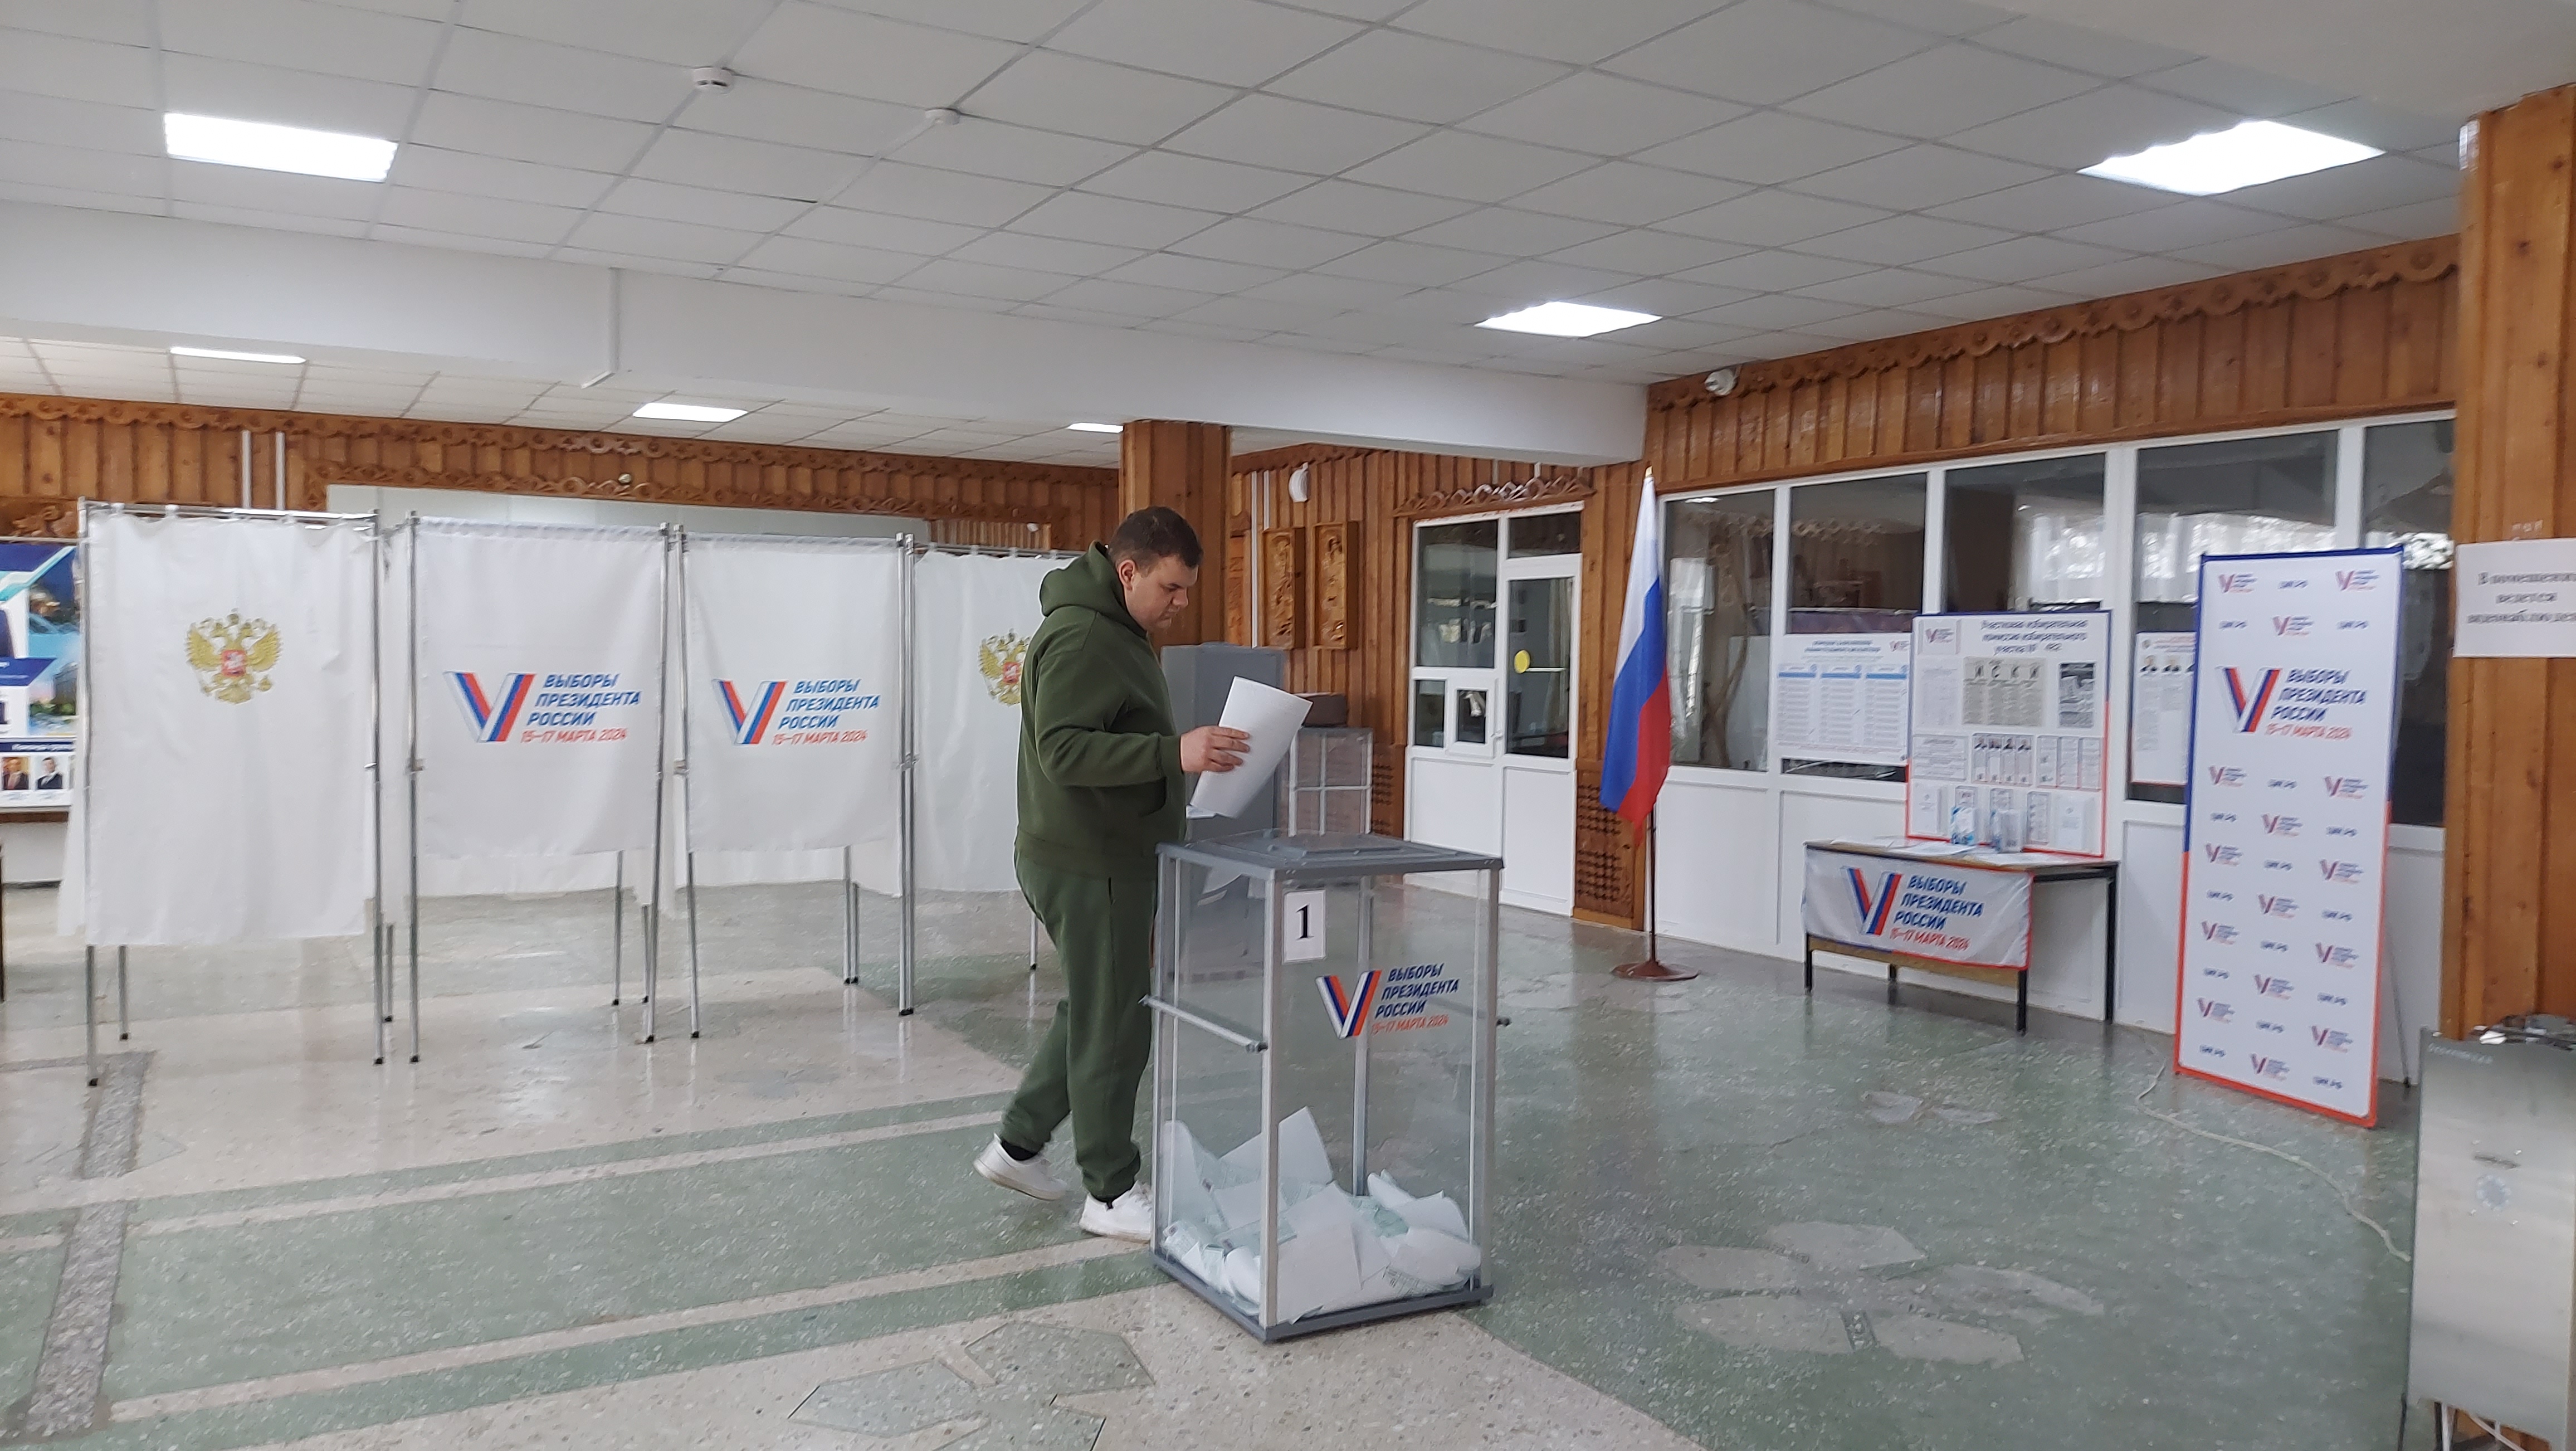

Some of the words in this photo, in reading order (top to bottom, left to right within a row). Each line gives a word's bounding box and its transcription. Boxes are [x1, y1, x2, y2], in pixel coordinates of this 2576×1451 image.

[543, 673, 620, 689] ВЫБОРЫ
[793, 679, 861, 694] ВЫБОРЫ
[535, 691, 642, 708] ПРЕЗИДЕНТА
[786, 695, 881, 712] ПРЕЗИДЕНТА
[526, 711, 597, 726] РОССИИ
[778, 714, 841, 731] РОССИИ
[557, 729, 595, 743] МАРТА
[598, 728, 628, 742] 2024
[803, 731, 838, 745] МАРТА
[840, 729, 868, 743] 2024
[1907, 875, 1967, 895] ВЫБОРЫ
[1900, 892, 1984, 917] ПРЕЗИДЕНТА
[1296, 903, 1314, 941] 1
[1894, 910, 1948, 931] РОССИИ
[1386, 963, 1445, 983] ВЫБОРЫ
[1380, 978, 1460, 1001] ПРЕЗИДЕНТА
[1374, 1000, 1428, 1019] РОССИИ
